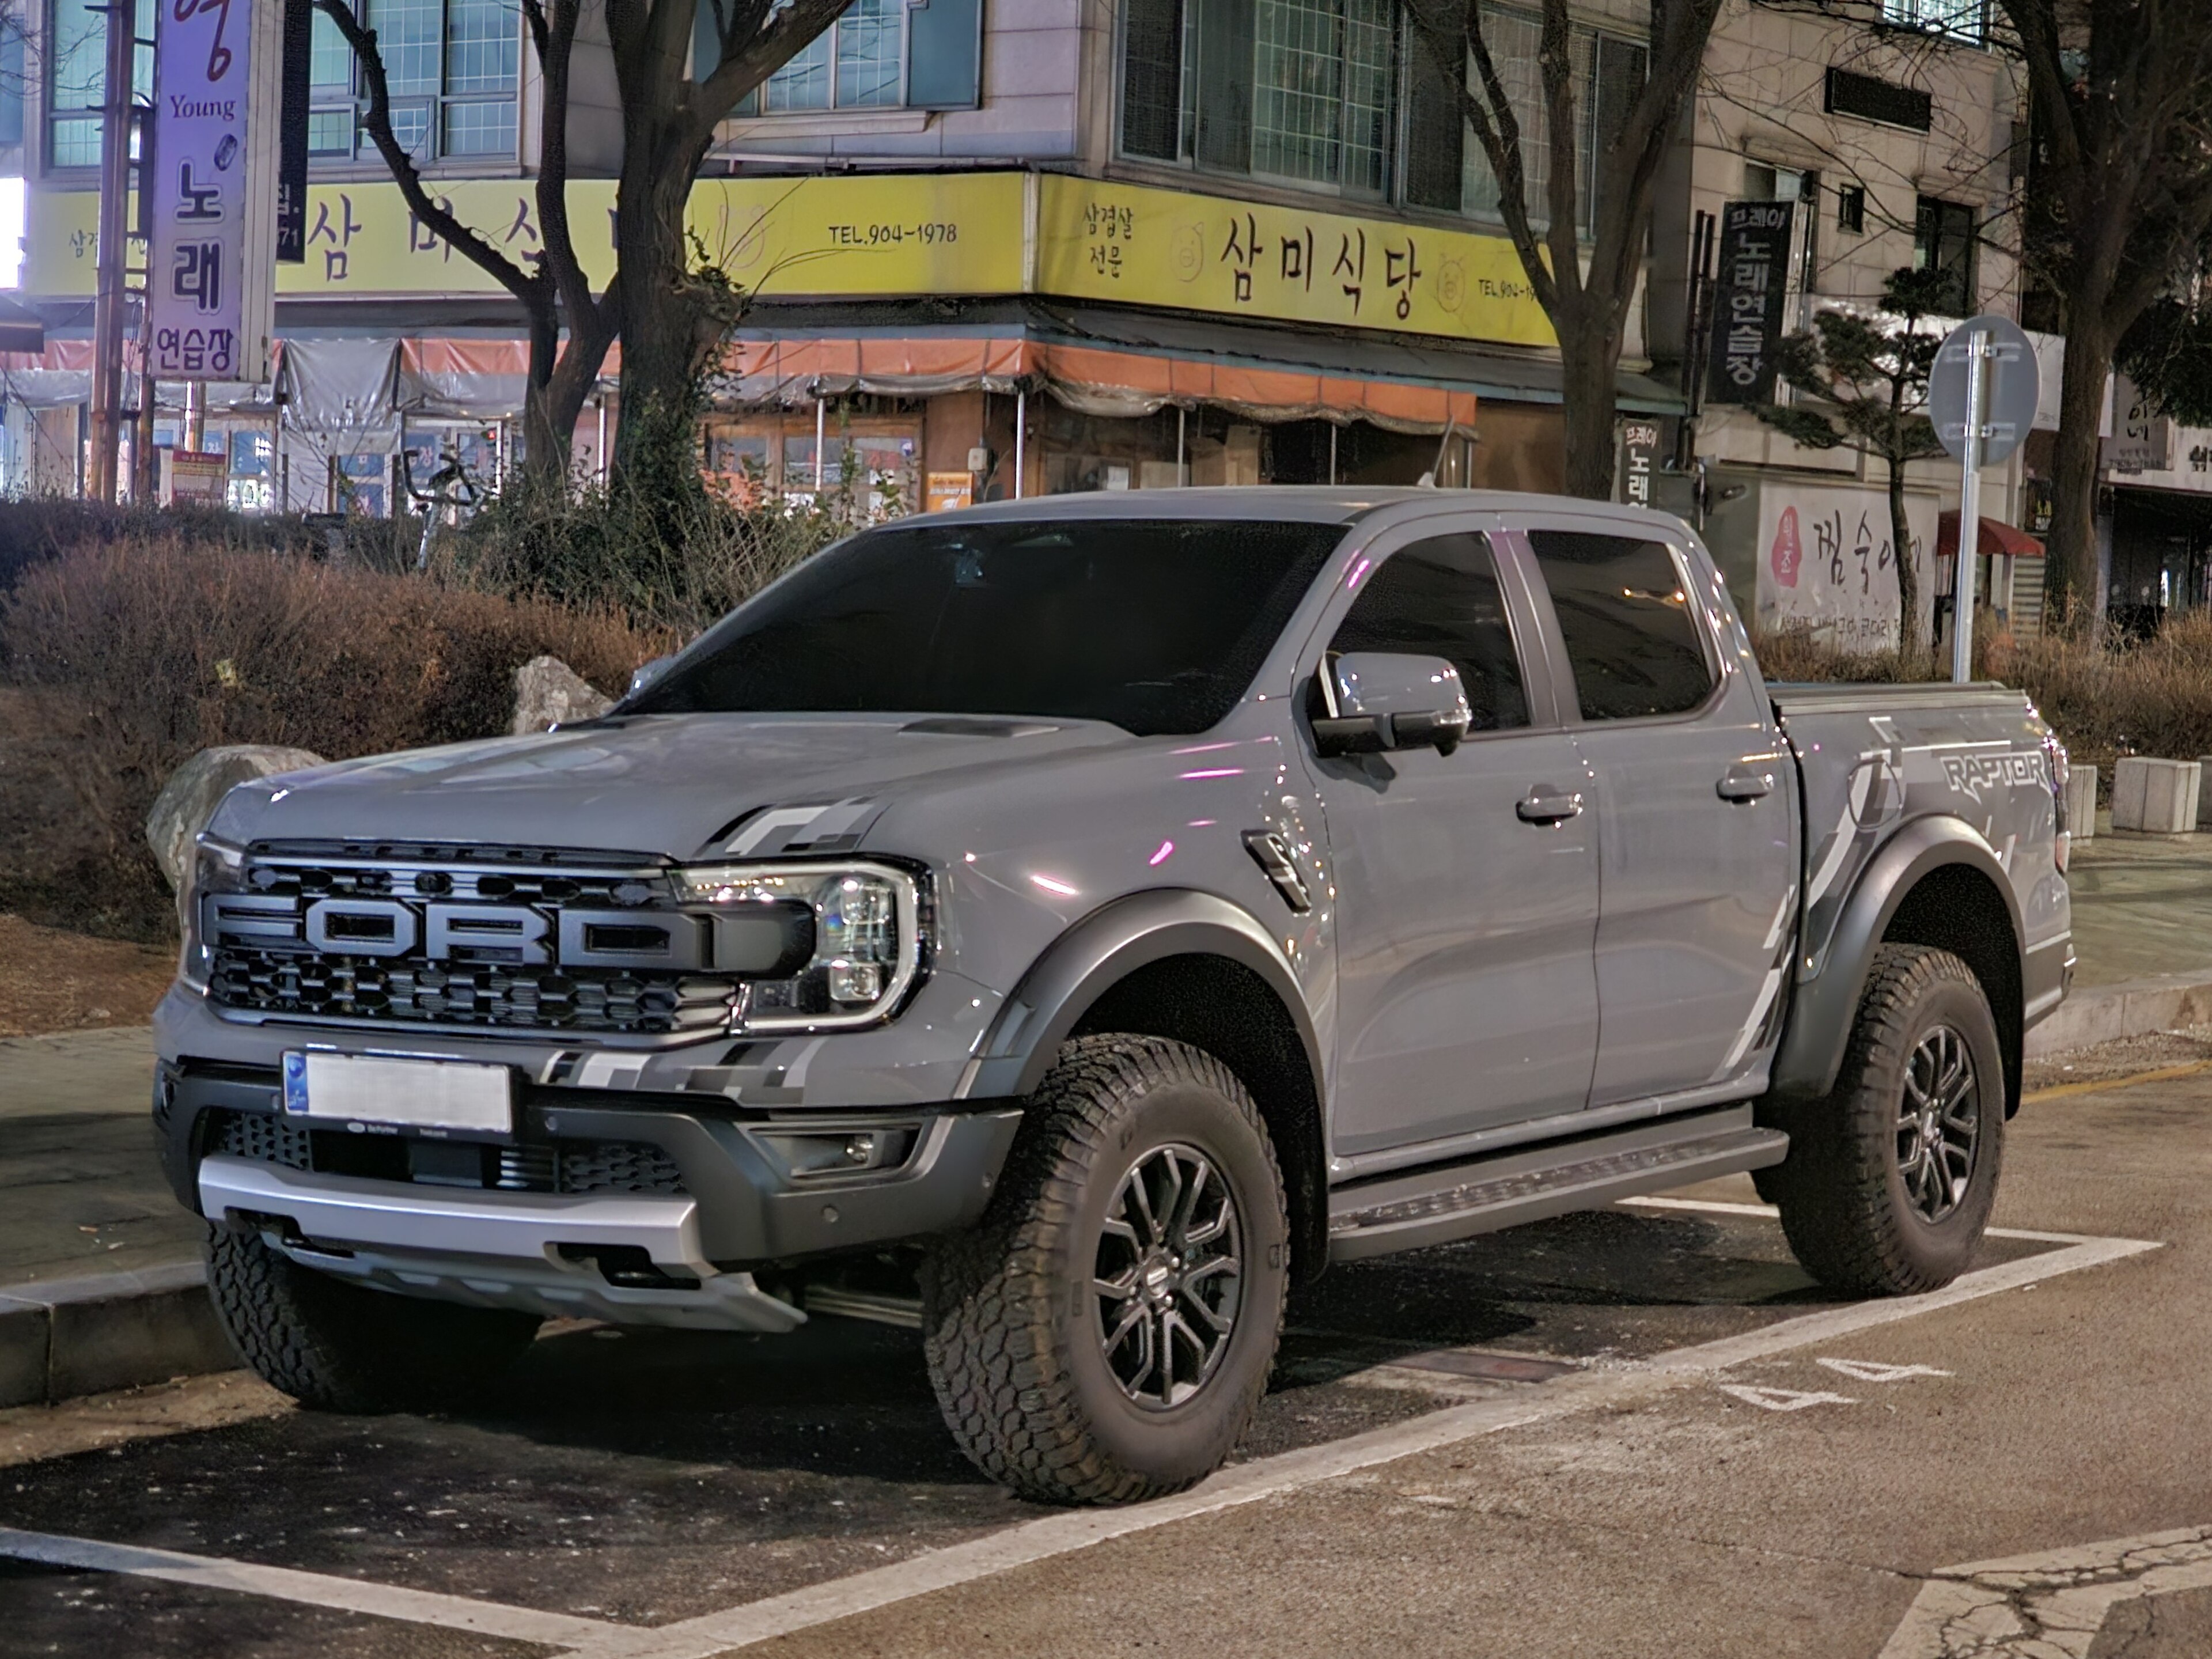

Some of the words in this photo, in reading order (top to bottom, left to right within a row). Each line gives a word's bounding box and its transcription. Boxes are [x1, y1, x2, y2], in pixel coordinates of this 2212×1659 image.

[171, 94, 236, 122] Young
[174, 163, 221, 309] 노래
[828, 224, 957, 245] TEL.904-1978
[1083, 202, 1134, 240] 삼겹살
[1090, 245, 1123, 278] 전문
[1220, 212, 1422, 320] 삼미식당
[157, 328, 233, 372] 연습장
[1940, 751, 2053, 805] RAPTOR
[203, 893, 703, 969] FORD
